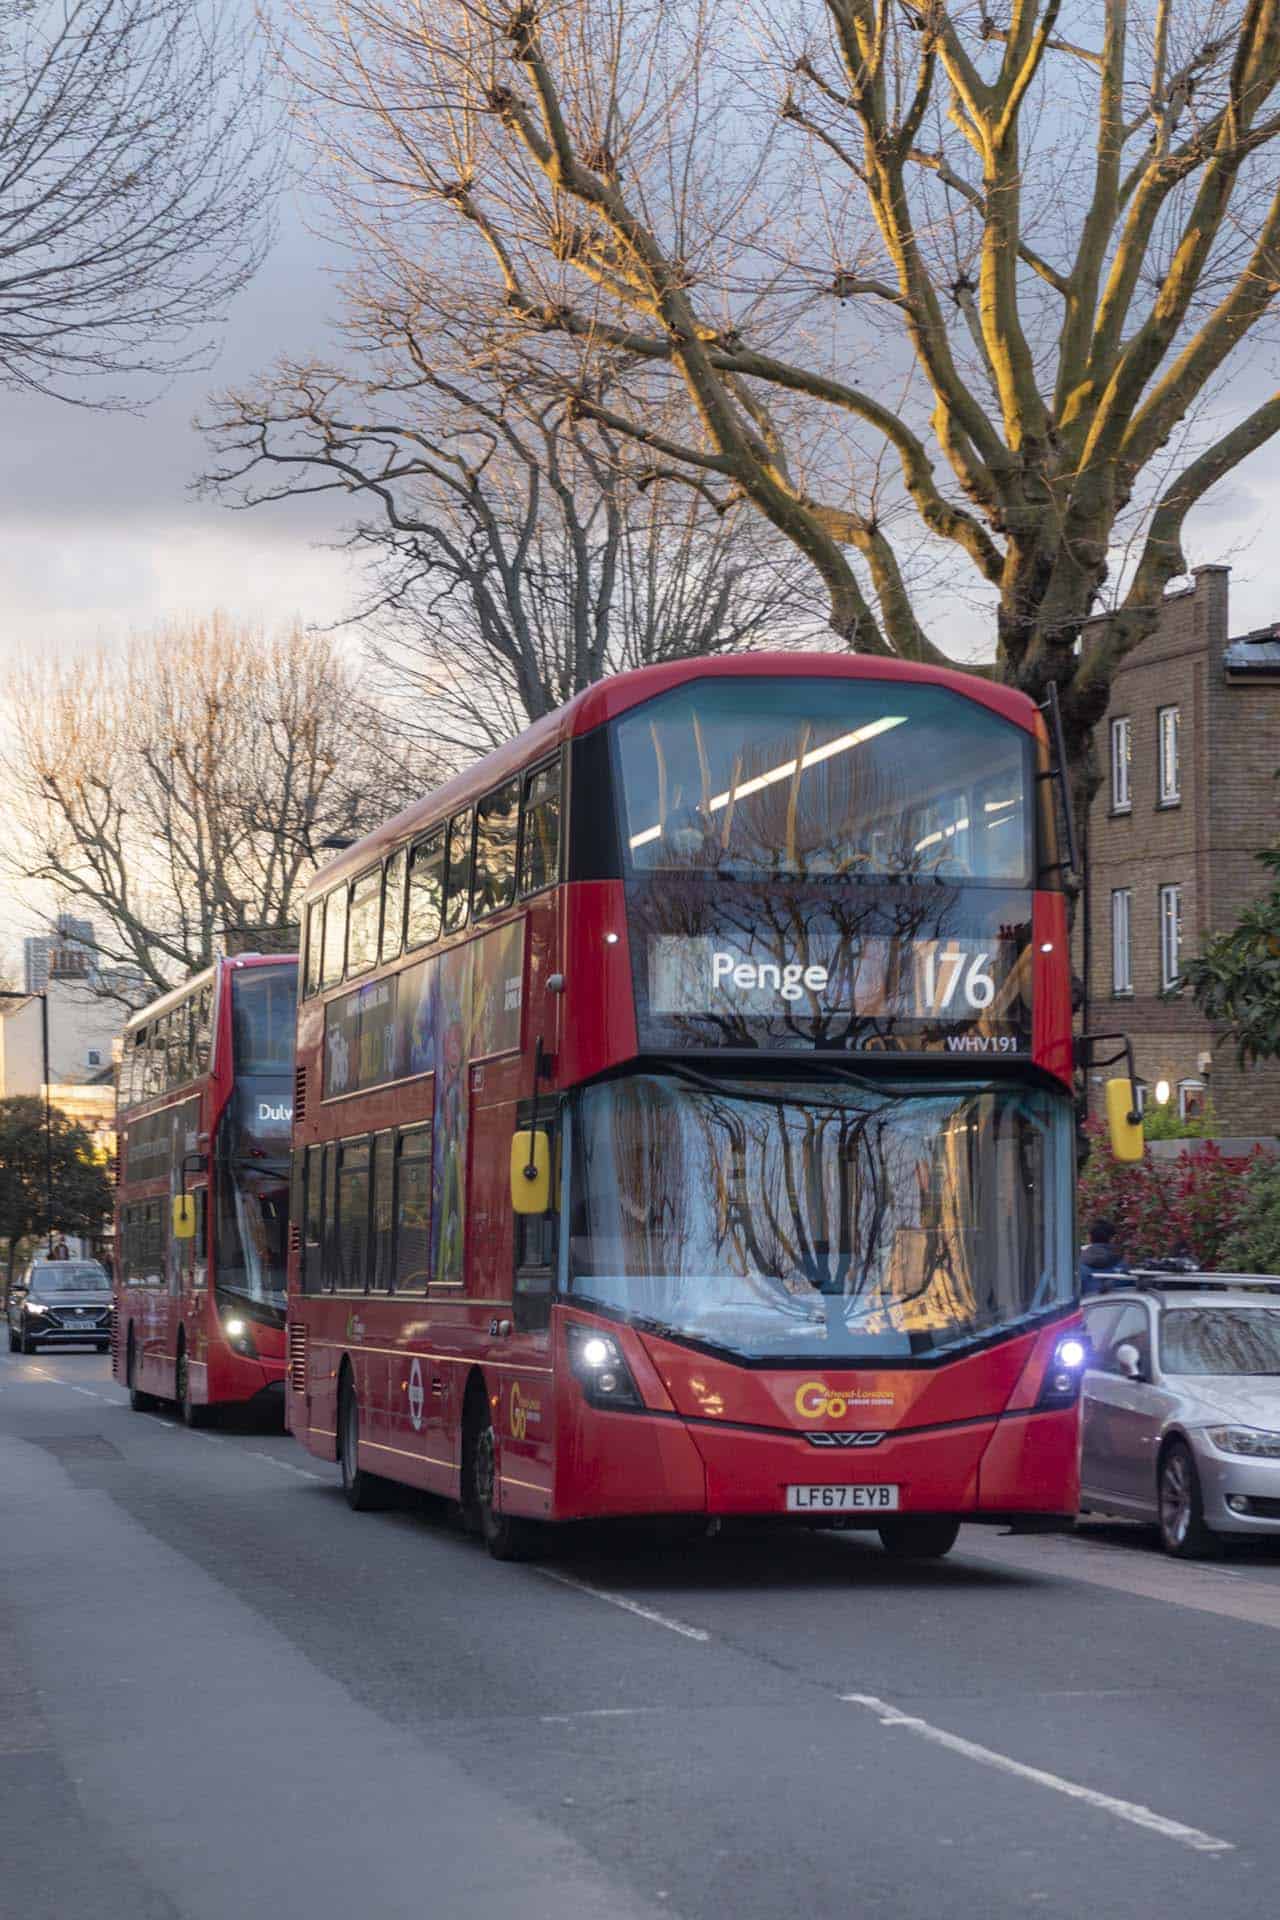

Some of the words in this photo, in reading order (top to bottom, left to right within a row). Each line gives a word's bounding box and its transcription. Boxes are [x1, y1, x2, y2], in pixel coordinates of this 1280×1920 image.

[711, 951, 829, 1001] Penge
[924, 951, 996, 1010] 176
[946, 1035, 1018, 1053] WHV191
[795, 1381, 847, 1419] Go
[795, 1487, 848, 1507] LF67
[852, 1487, 891, 1507] EYB
